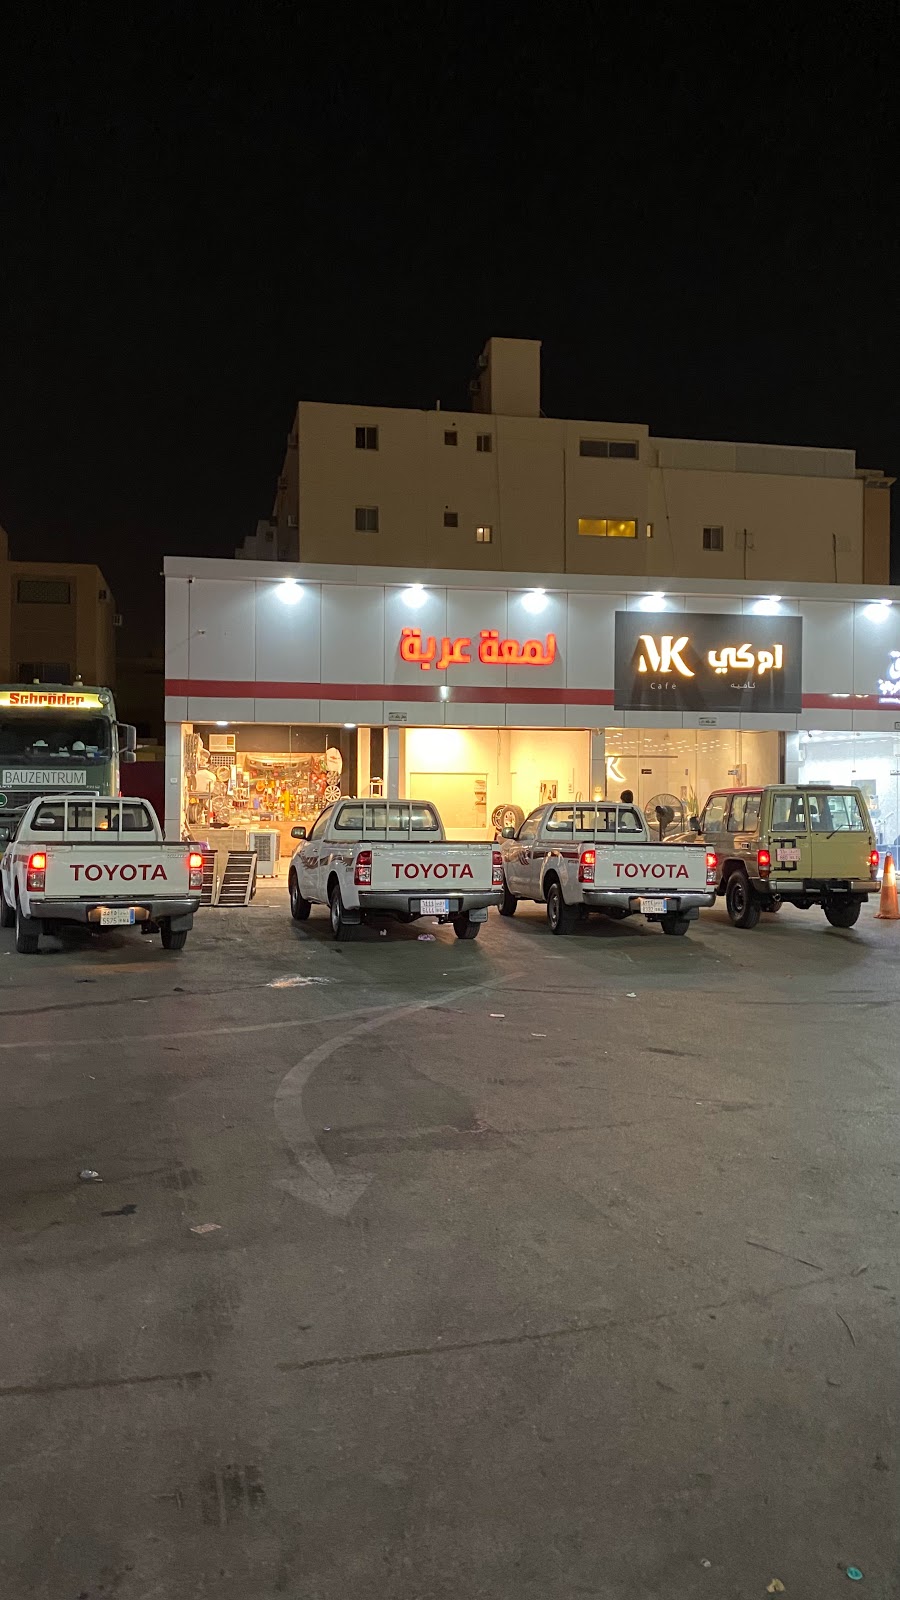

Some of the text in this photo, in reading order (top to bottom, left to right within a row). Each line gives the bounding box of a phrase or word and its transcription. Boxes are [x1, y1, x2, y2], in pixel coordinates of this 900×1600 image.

[401, 628, 556, 670] لمعة عربة
[638, 635, 695, 677] MK
[9, 692, 85, 706] Schröder
[5, 771, 84, 785] BAUZENTRUM
[70, 864, 168, 882] TOYOTA
[391, 863, 474, 879] TOYOTA
[613, 863, 689, 879] TOYOTA
